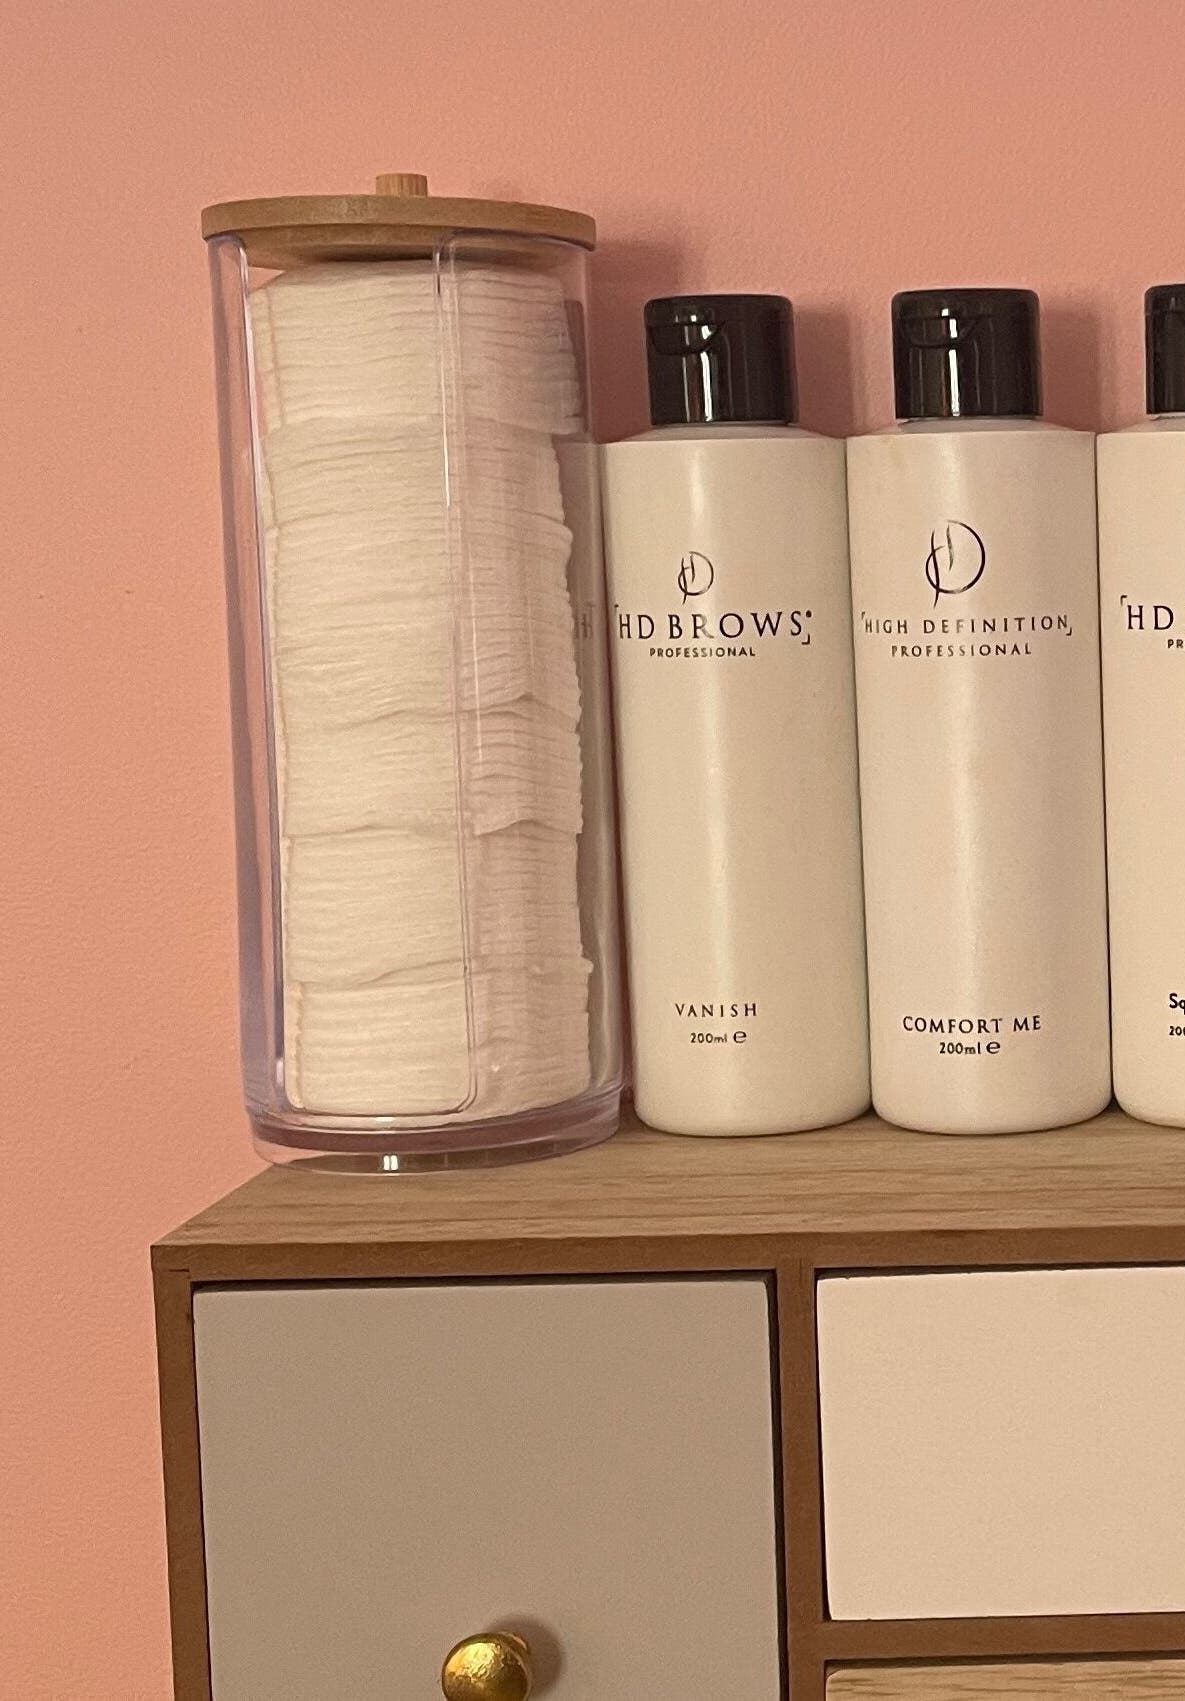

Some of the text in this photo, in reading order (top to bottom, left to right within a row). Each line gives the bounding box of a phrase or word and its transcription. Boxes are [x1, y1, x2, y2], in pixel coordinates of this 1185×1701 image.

[864, 614, 1068, 634] HIGH DEFINITION
[1127, 605, 1174, 630] HD
[618, 613, 655, 640] HD
[667, 611, 802, 639] BROWS
[649, 646, 756, 659] PROFESSIONAL
[891, 642, 1032, 657] PROFESSIONAL
[675, 1003, 757, 1017] VANISH
[902, 1015, 1042, 1033] COMFORT ME
[690, 1032, 728, 1044] 200ml
[939, 1042, 981, 1055] 200ml
